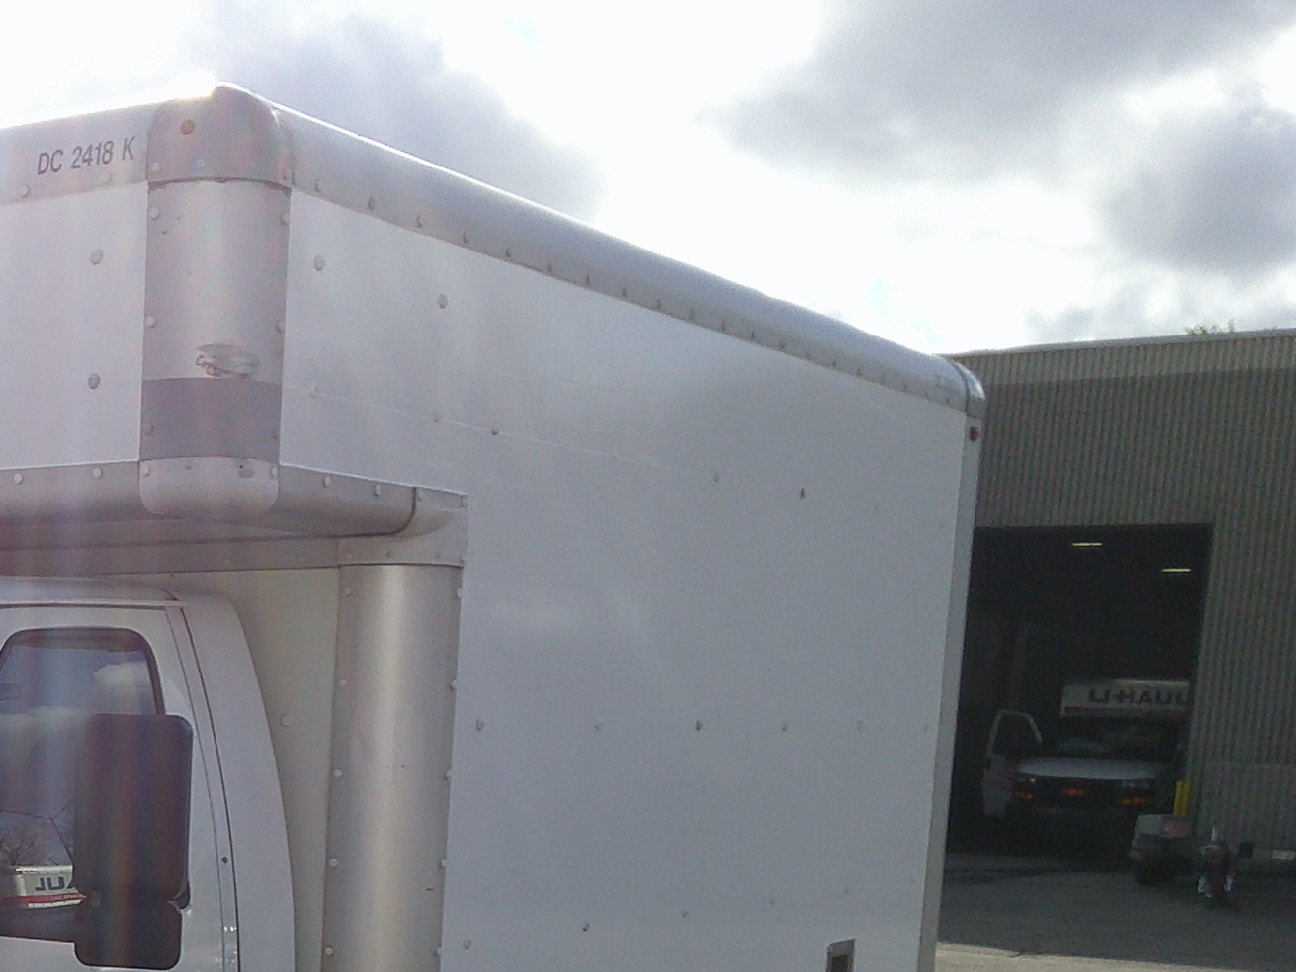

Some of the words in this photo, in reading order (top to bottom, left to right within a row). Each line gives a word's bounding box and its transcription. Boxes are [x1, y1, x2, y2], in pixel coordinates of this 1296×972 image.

[37, 149, 63, 175] DC
[70, 140, 115, 169] 2418
[122, 136, 135, 160] K
